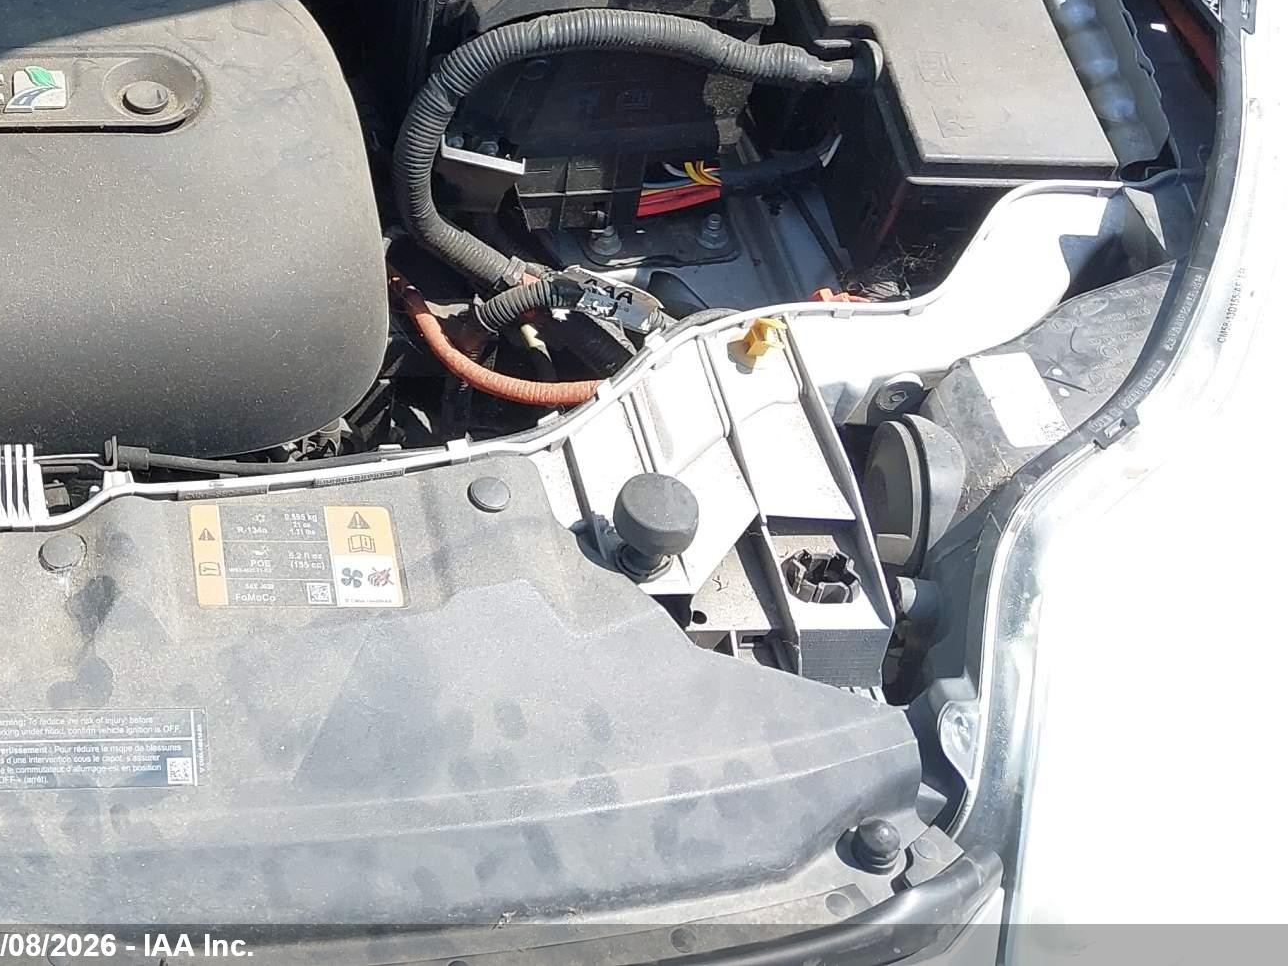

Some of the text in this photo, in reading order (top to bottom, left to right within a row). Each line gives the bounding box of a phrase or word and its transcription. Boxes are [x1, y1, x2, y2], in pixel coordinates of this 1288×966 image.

[307, 513, 318, 523] kg
[236, 526, 268, 534] R-134a
[250, 559, 272, 568] POE
[235, 593, 276, 602] FoMoCo
[95, 716, 104, 724] of
[130, 716, 152, 724] before
[22, 728, 44, 736] under
[163, 724, 182, 733] OFF.
[54, 745, 72, 753] Pour
[73, 745, 100, 753] réduire
[110, 745, 132, 754] risque
[146, 744, 182, 752] blessures
[132, 764, 162, 772] position
